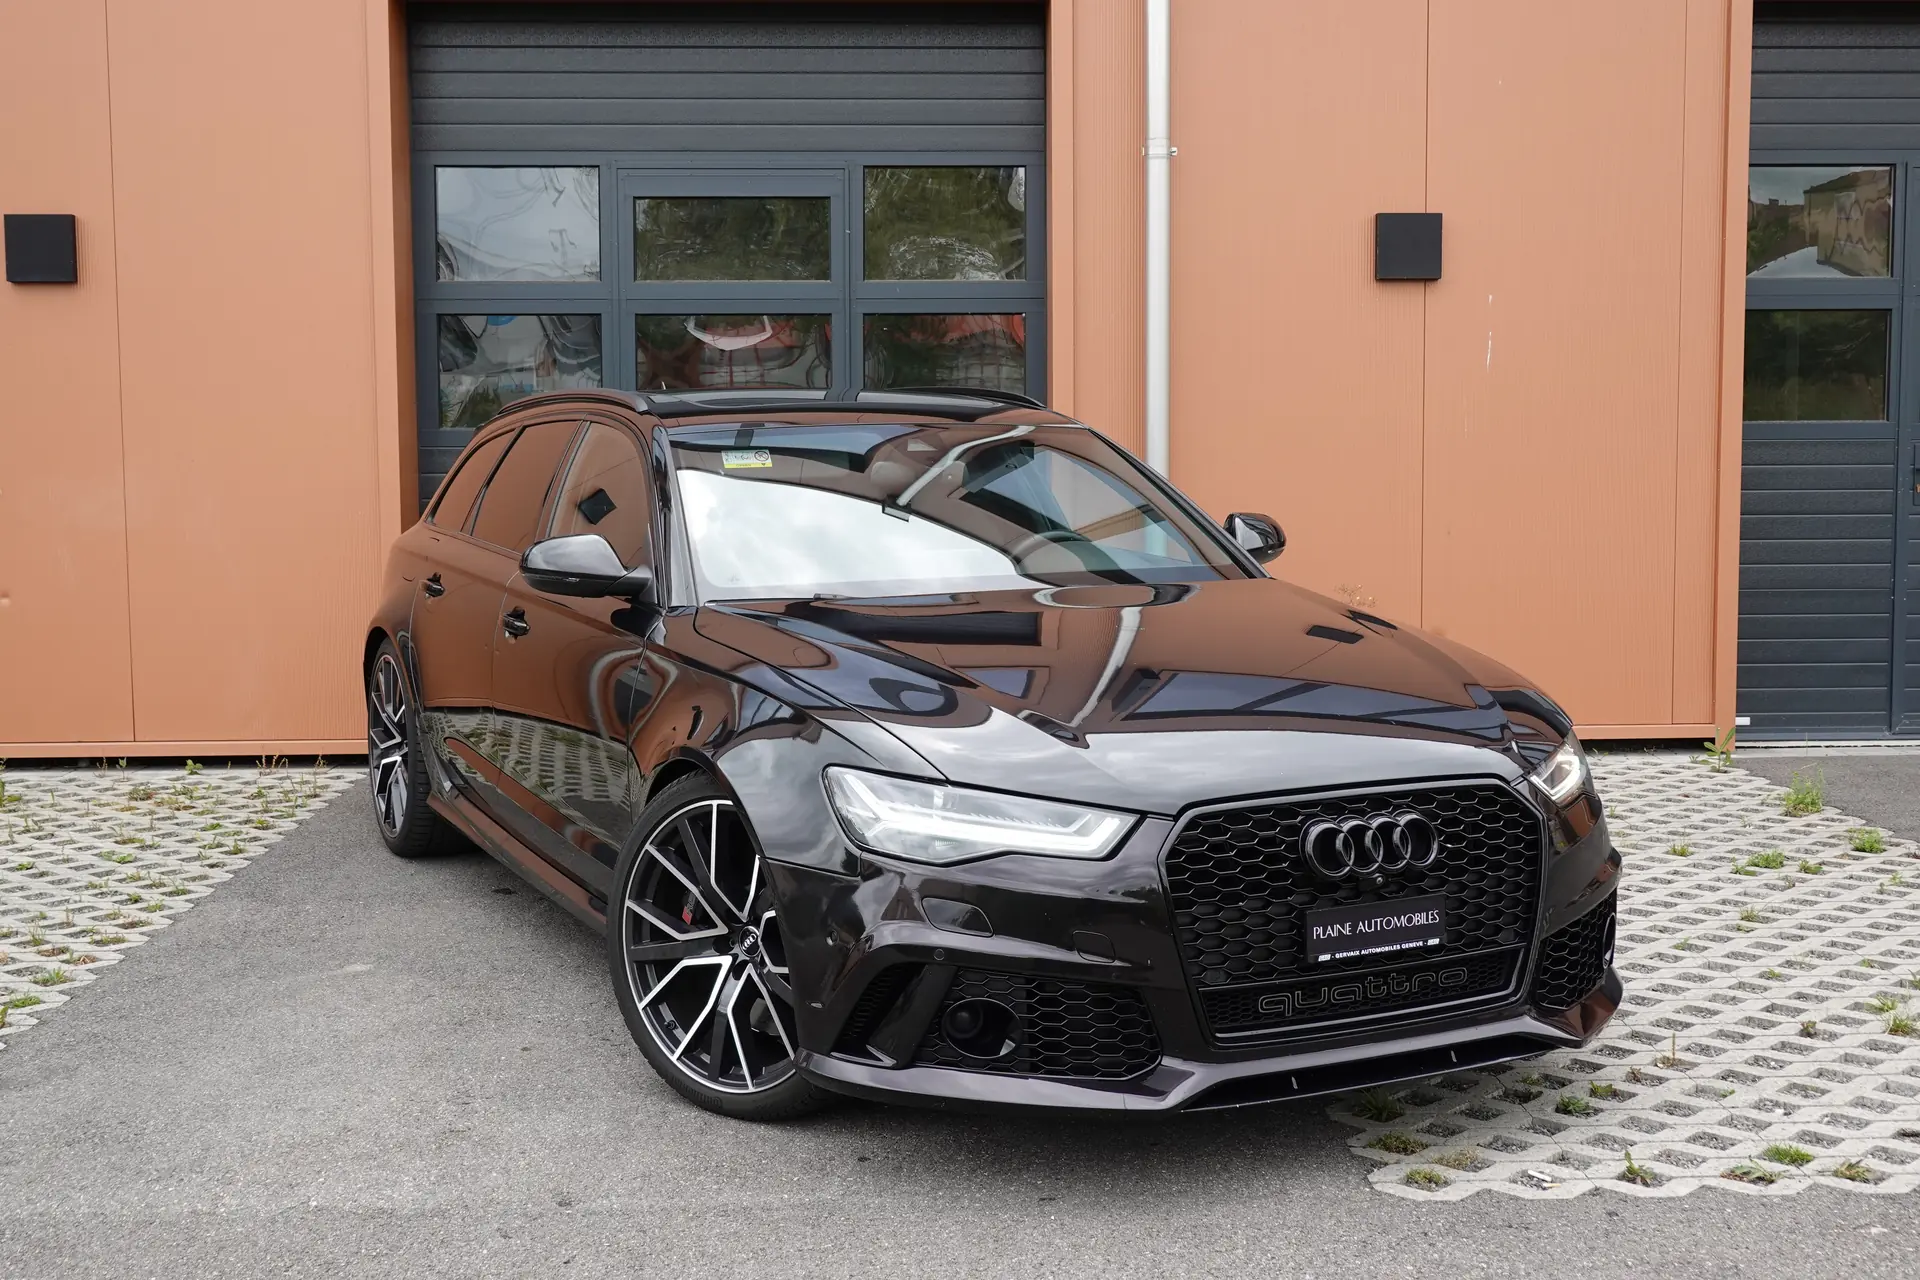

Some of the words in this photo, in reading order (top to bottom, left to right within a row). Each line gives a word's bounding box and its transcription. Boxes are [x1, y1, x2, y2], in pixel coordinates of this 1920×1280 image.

[1313, 922, 1352, 940] PLAINE
[1356, 910, 1440, 934] AUTOMOBILES
[1335, 950, 1360, 959] GERVAIX
[1361, 944, 1401, 955] AUTOMOBILES
[1401, 941, 1424, 949] GENEVE
[1258, 967, 1468, 1016] quattro
